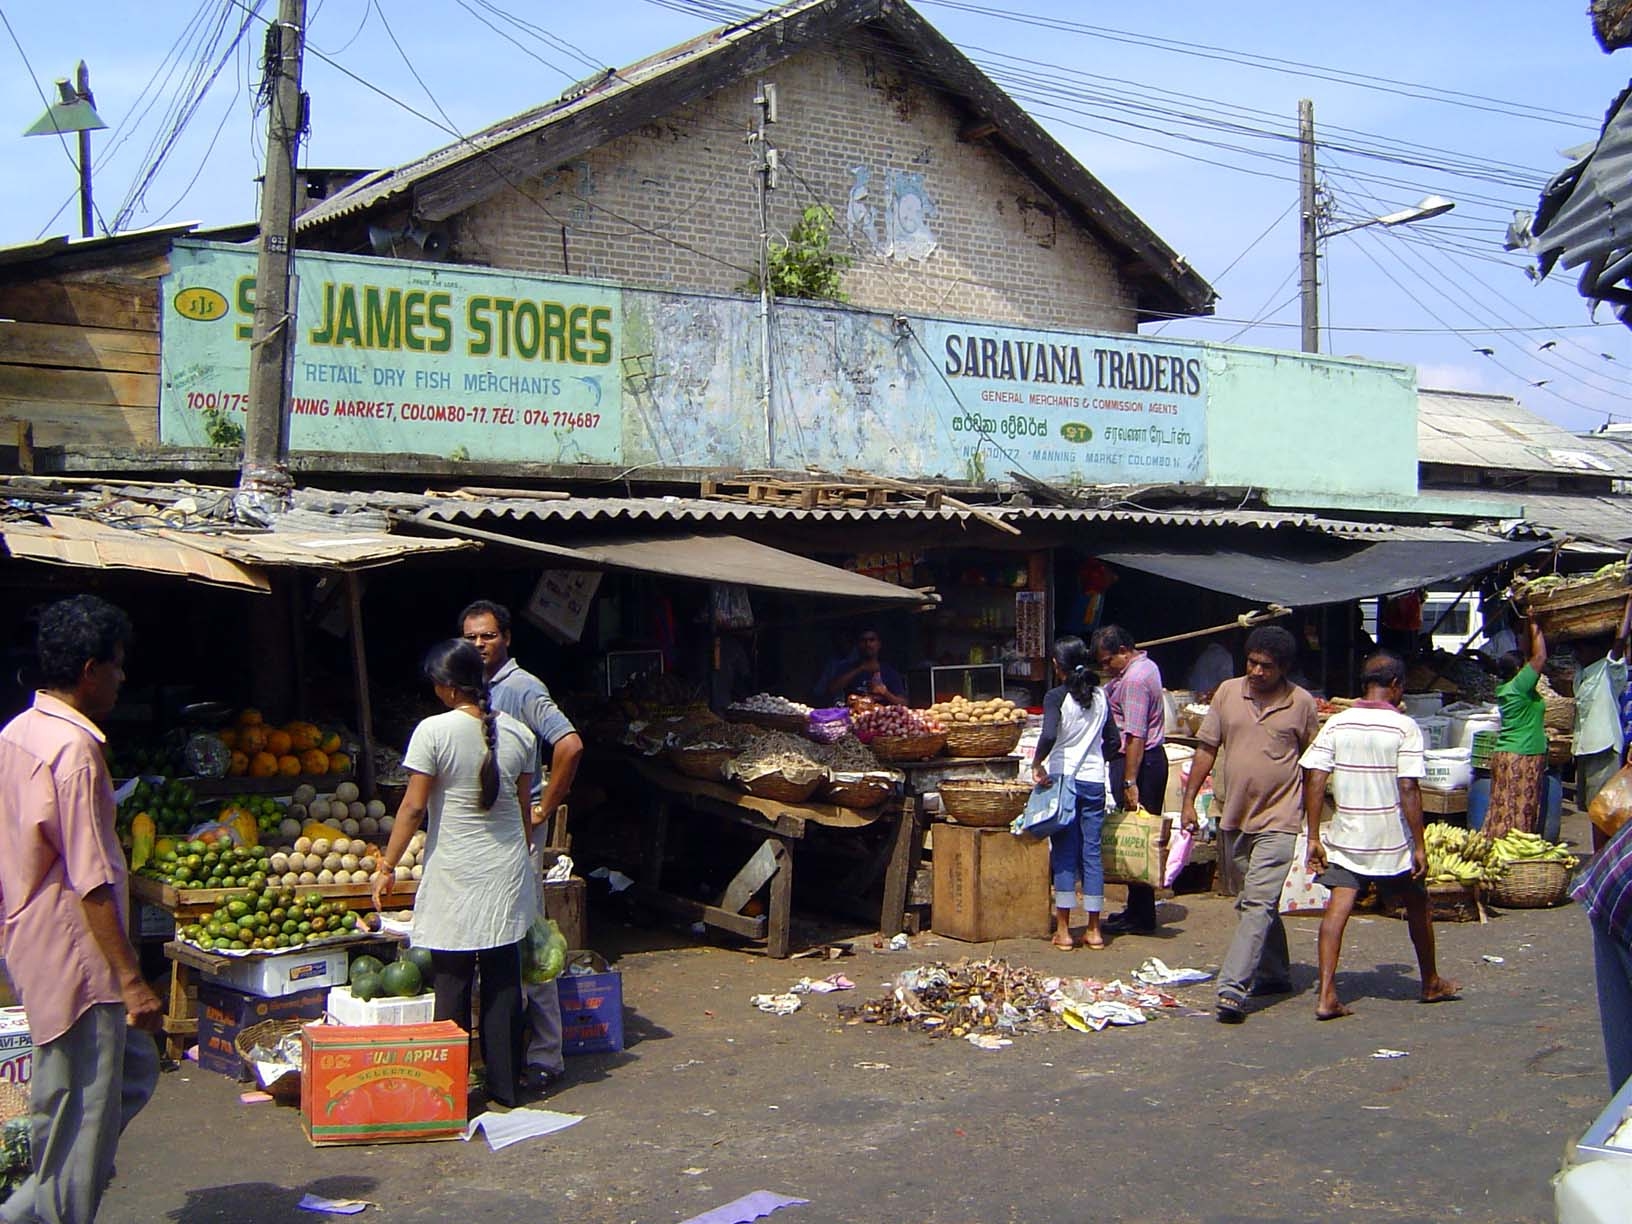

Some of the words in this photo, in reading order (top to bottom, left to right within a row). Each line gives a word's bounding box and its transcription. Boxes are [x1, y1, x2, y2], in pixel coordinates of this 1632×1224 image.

[310, 281, 452, 354] JAMES
[466, 295, 612, 365] STORES
[945, 334, 1085, 387] SARAVANA
[1094, 349, 1200, 396] TRADERS
[305, 363, 362, 384] RETAIL
[373, 368, 405, 388] DRY
[416, 370, 450, 389] FISH
[464, 373, 561, 396] MERCHANTS
[981, 390, 1024, 404] GENERAL
[1029, 393, 1079, 408] MERCHANTS
[1082, 398, 1090, 408] &
[1092, 398, 1142, 412] COMMISSION
[1149, 403, 1178, 415] AGENTS
[1066, 427, 1086, 439] ST
[1086, 453, 1123, 465] MARKET
[1128, 454, 1171, 467] COLOMBO
[404, 1049, 449, 1062] APPLE
